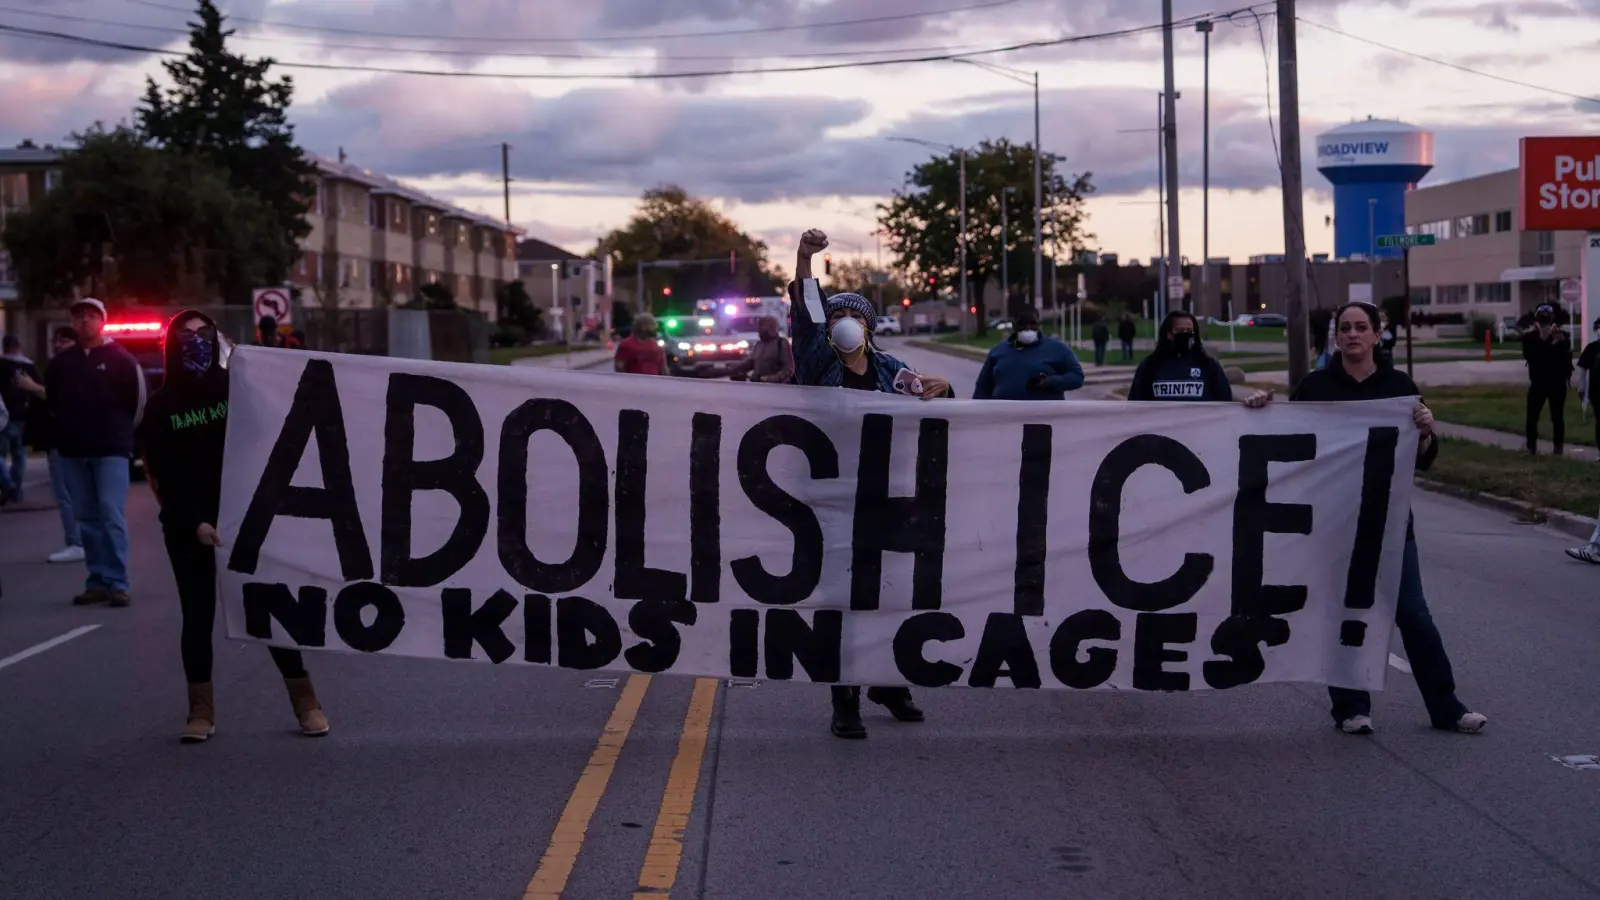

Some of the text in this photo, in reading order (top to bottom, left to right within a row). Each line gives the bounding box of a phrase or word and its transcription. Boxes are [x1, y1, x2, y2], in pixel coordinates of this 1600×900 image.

[1384, 236, 1420, 247] FILLMORE
[1153, 383, 1203, 396] TRINITY
[227, 358, 1399, 647] ABOLISH ICE!
[242, 581, 1291, 692] NO KIDS IN CAGES
